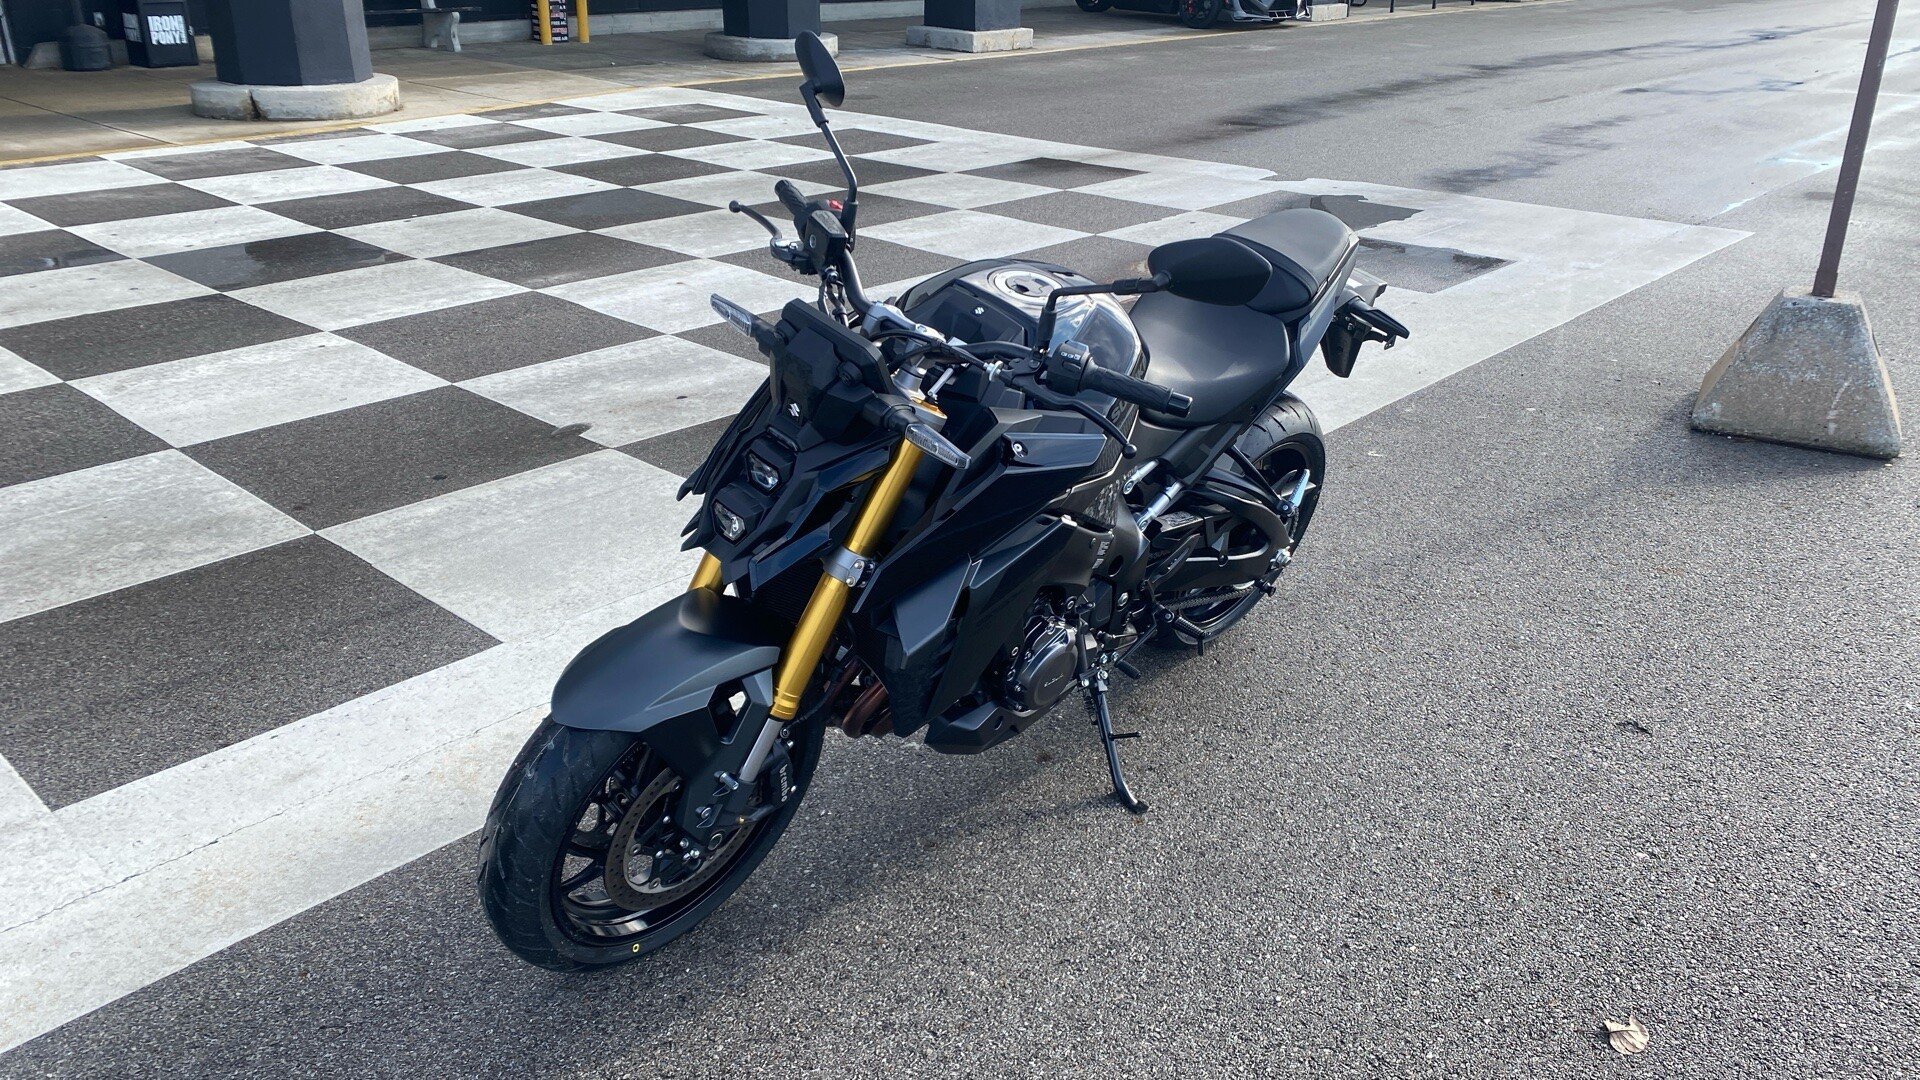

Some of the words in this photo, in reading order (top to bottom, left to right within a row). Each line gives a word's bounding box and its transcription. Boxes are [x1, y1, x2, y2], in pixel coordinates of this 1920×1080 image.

[147, 15, 180, 31] IRON
[150, 31, 181, 45] PONY
[779, 764, 790, 802] brembo
